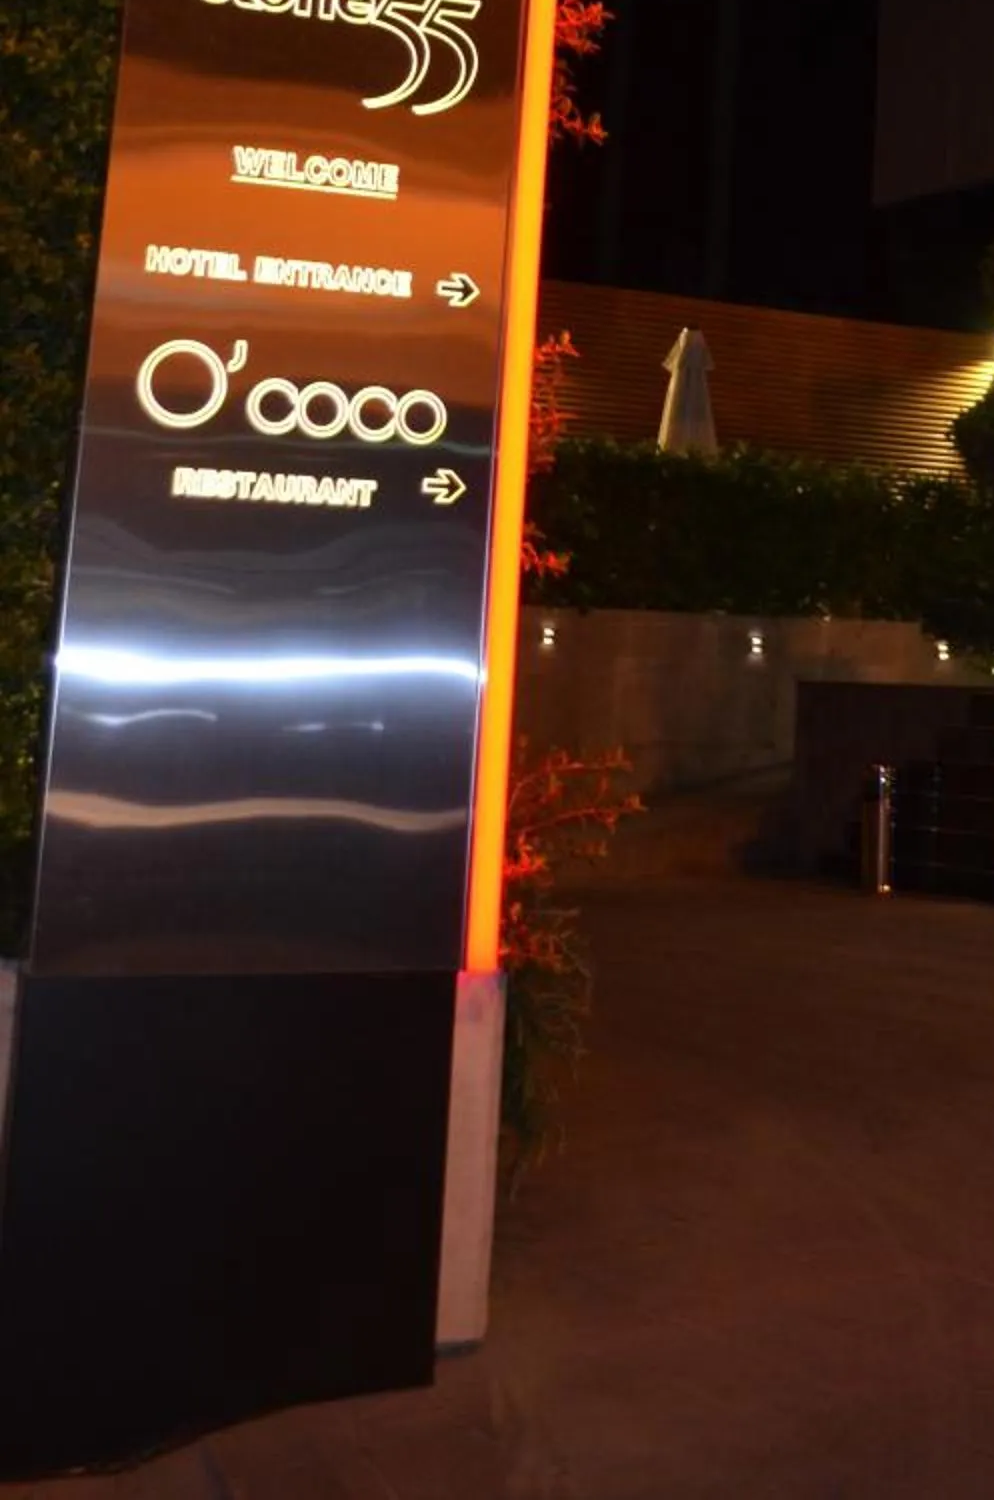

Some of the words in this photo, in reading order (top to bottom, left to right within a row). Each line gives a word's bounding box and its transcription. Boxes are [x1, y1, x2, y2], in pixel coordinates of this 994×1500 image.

[232, 145, 400, 195] WELCOME
[144, 244, 248, 283] HOTEL
[253, 255, 413, 299] ENTRANCE
[171, 466, 379, 508] RESTAURANT
